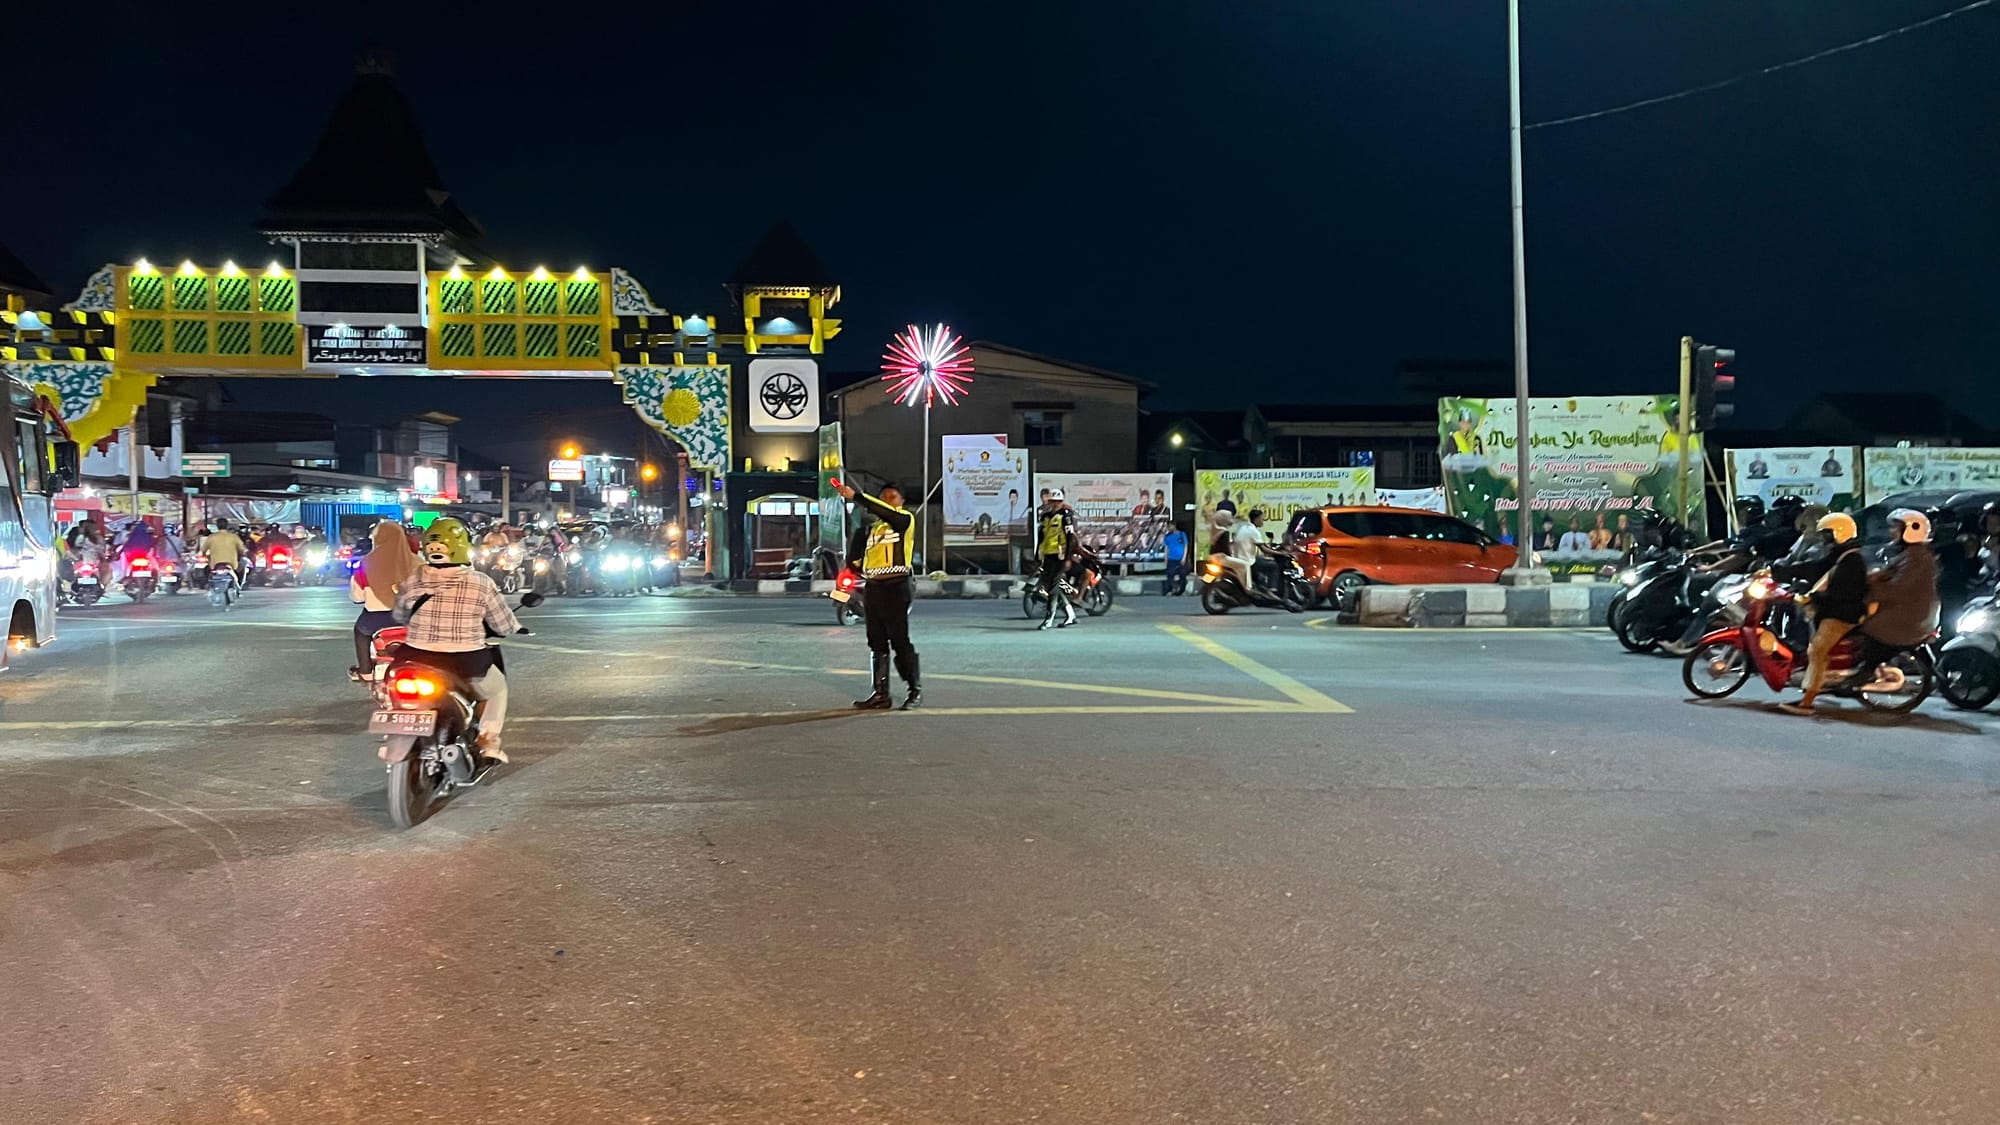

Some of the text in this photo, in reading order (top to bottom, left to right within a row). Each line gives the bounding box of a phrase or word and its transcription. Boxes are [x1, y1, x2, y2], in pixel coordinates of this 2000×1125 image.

[1561, 430, 1584, 449] Ya
[1588, 429, 1661, 448] Ramadhan
[1585, 459, 1649, 474] Ramadhan
[1221, 472, 1252, 481] KELUARGA
[1253, 471, 1273, 480] BESAR
[1274, 471, 1300, 480] BARISAN
[1300, 470, 1324, 479] PEMUDA
[1563, 476, 1583, 485] dan
[392, 713, 417, 724] 5609
[418, 714, 432, 725] SX
